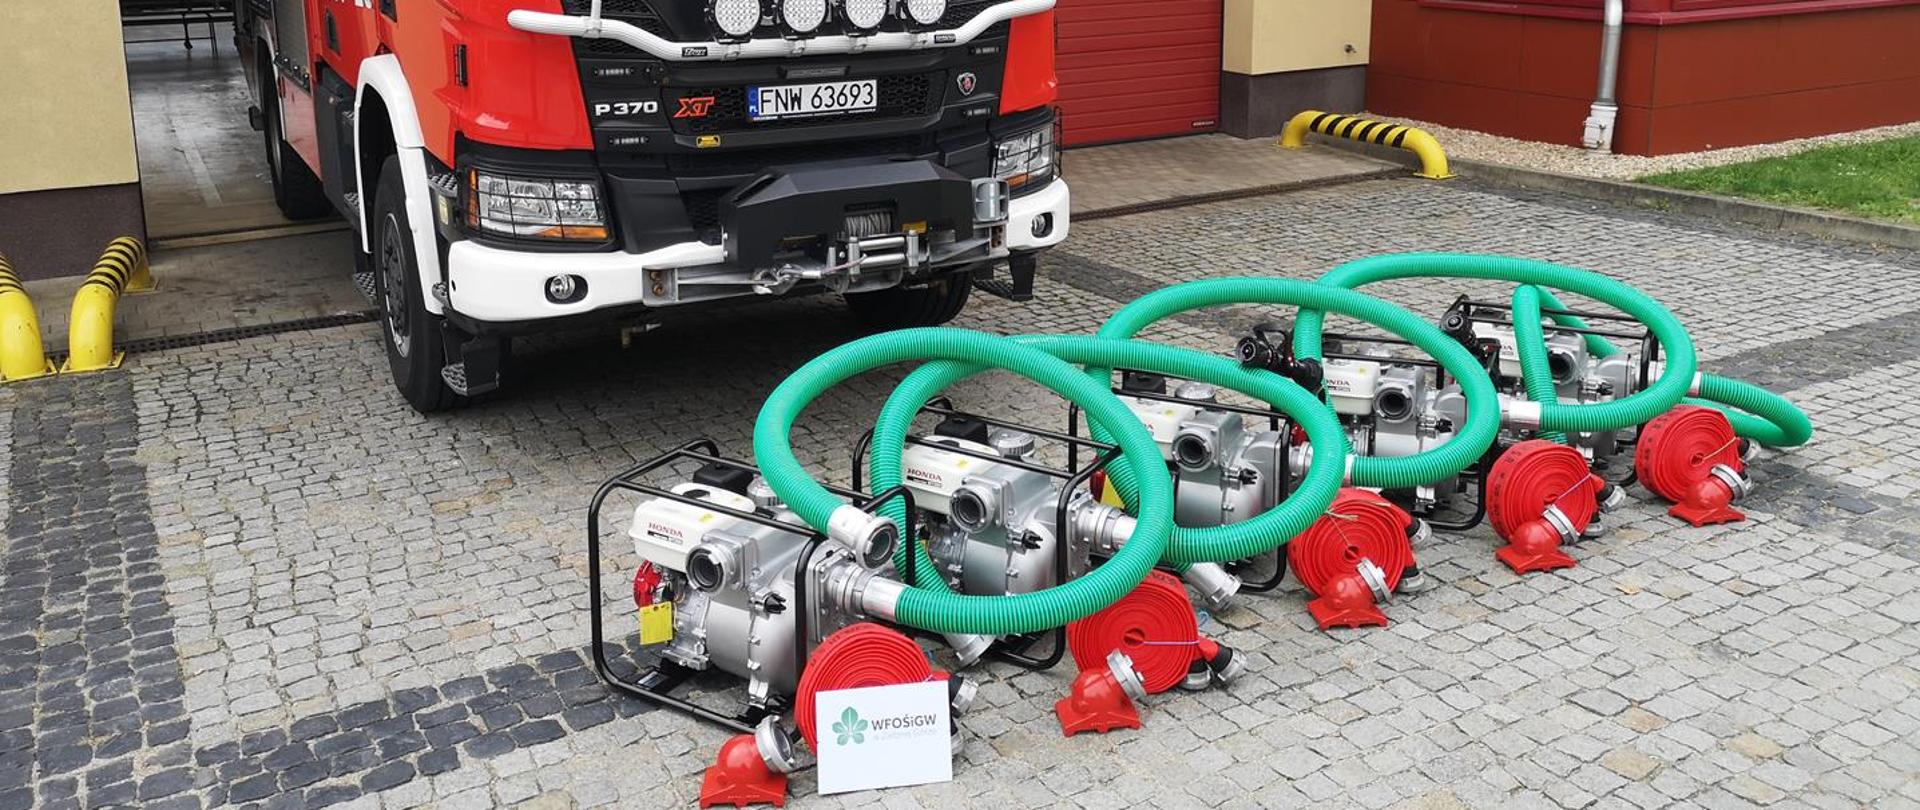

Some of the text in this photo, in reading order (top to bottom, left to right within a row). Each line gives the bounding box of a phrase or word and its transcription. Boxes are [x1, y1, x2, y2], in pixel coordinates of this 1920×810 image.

[760, 82, 874, 113] FNW 63693
[595, 101, 658, 116] P 370
[673, 96, 715, 118] XT
[749, 105, 758, 113] PL
[907, 468, 942, 481] HONDA
[649, 522, 683, 537] HONDA
[871, 713, 936, 731] WFOŚiGW
